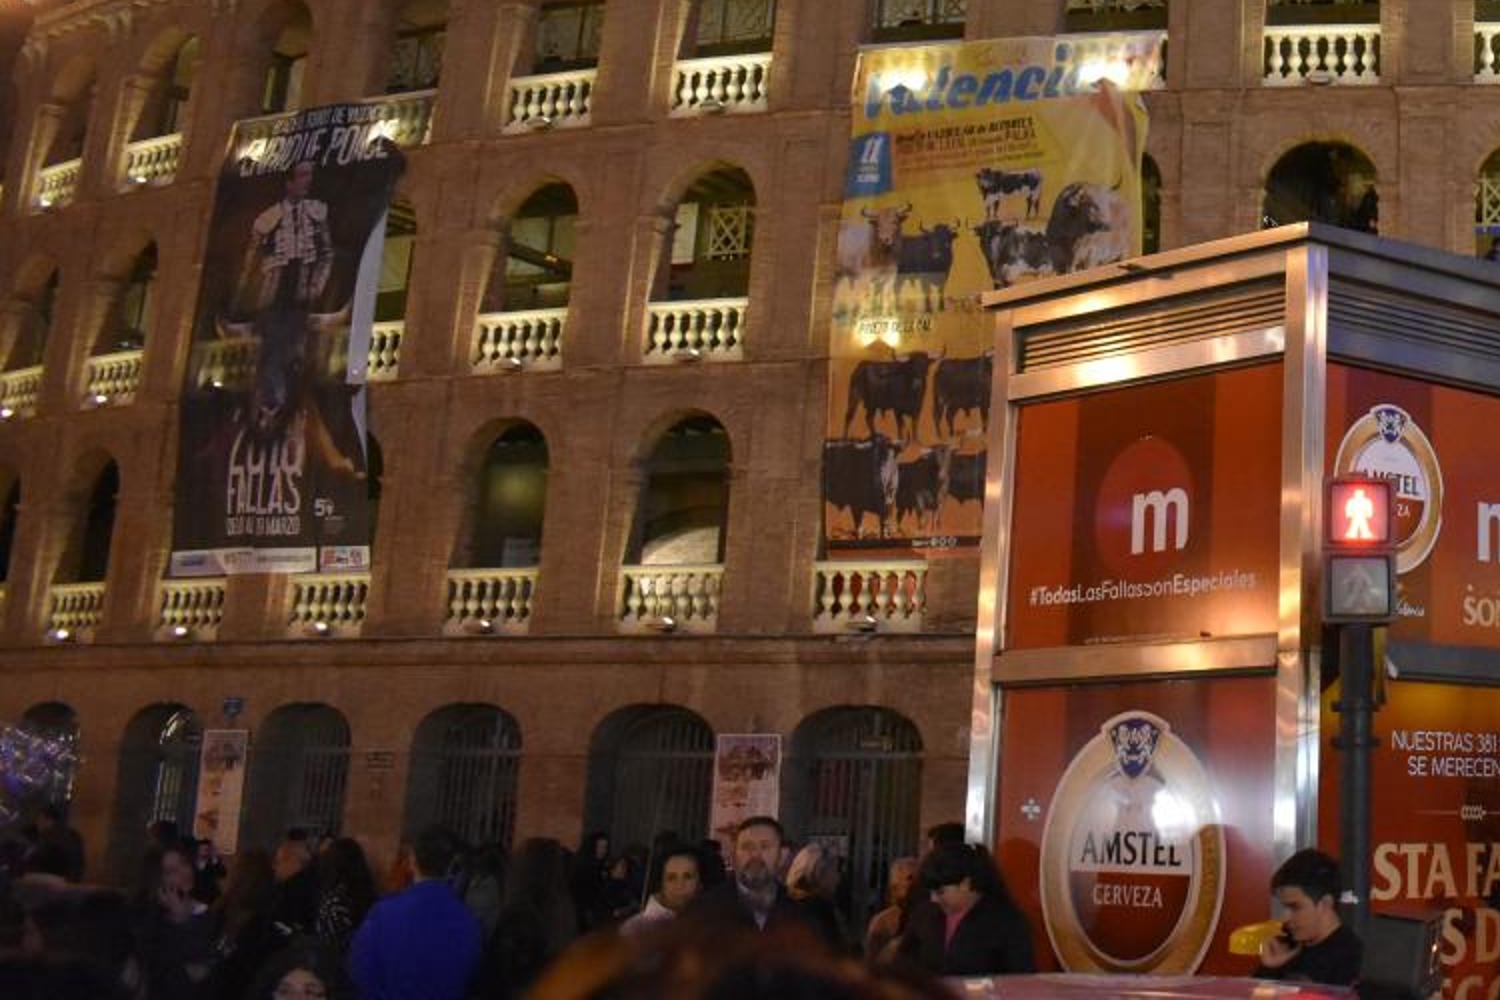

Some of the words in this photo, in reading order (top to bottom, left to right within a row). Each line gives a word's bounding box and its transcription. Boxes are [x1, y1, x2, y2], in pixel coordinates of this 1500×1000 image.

[226, 467, 302, 515] FALLAS
[1131, 487, 1189, 555] m
[1391, 730, 1474, 753] NUESTRAS
[1407, 755, 1429, 777] SE
[1081, 830, 1182, 867] AMSTEL
[1370, 842, 1459, 901] STA
[1092, 884, 1163, 908] CERVEZA
